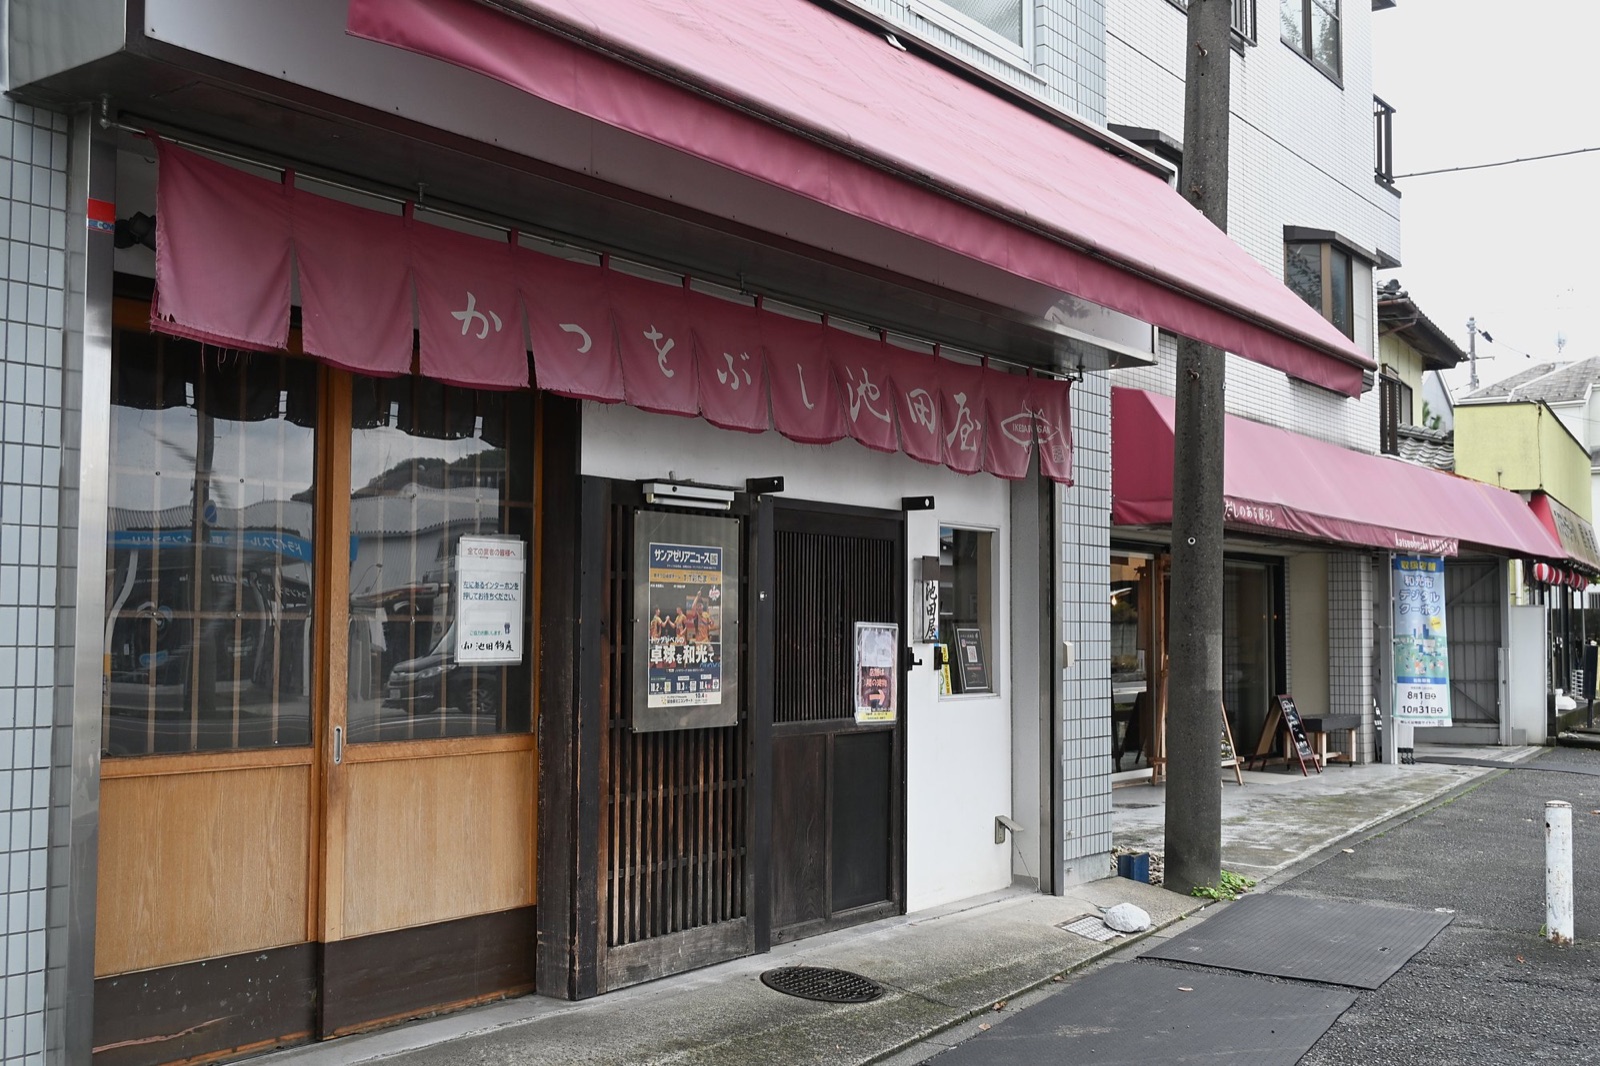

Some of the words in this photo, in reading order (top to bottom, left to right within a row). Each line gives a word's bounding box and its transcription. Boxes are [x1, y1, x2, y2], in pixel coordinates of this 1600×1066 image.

[463, 580, 519, 590] 左にあるインターホンを
[1403, 575, 1434, 589] 和光市
[463, 592, 516, 601] 押してお待ちください。
[1399, 589, 1441, 603] デジタル
[925, 581, 938, 639] 池田屋
[1399, 603, 1441, 616] クーポン
